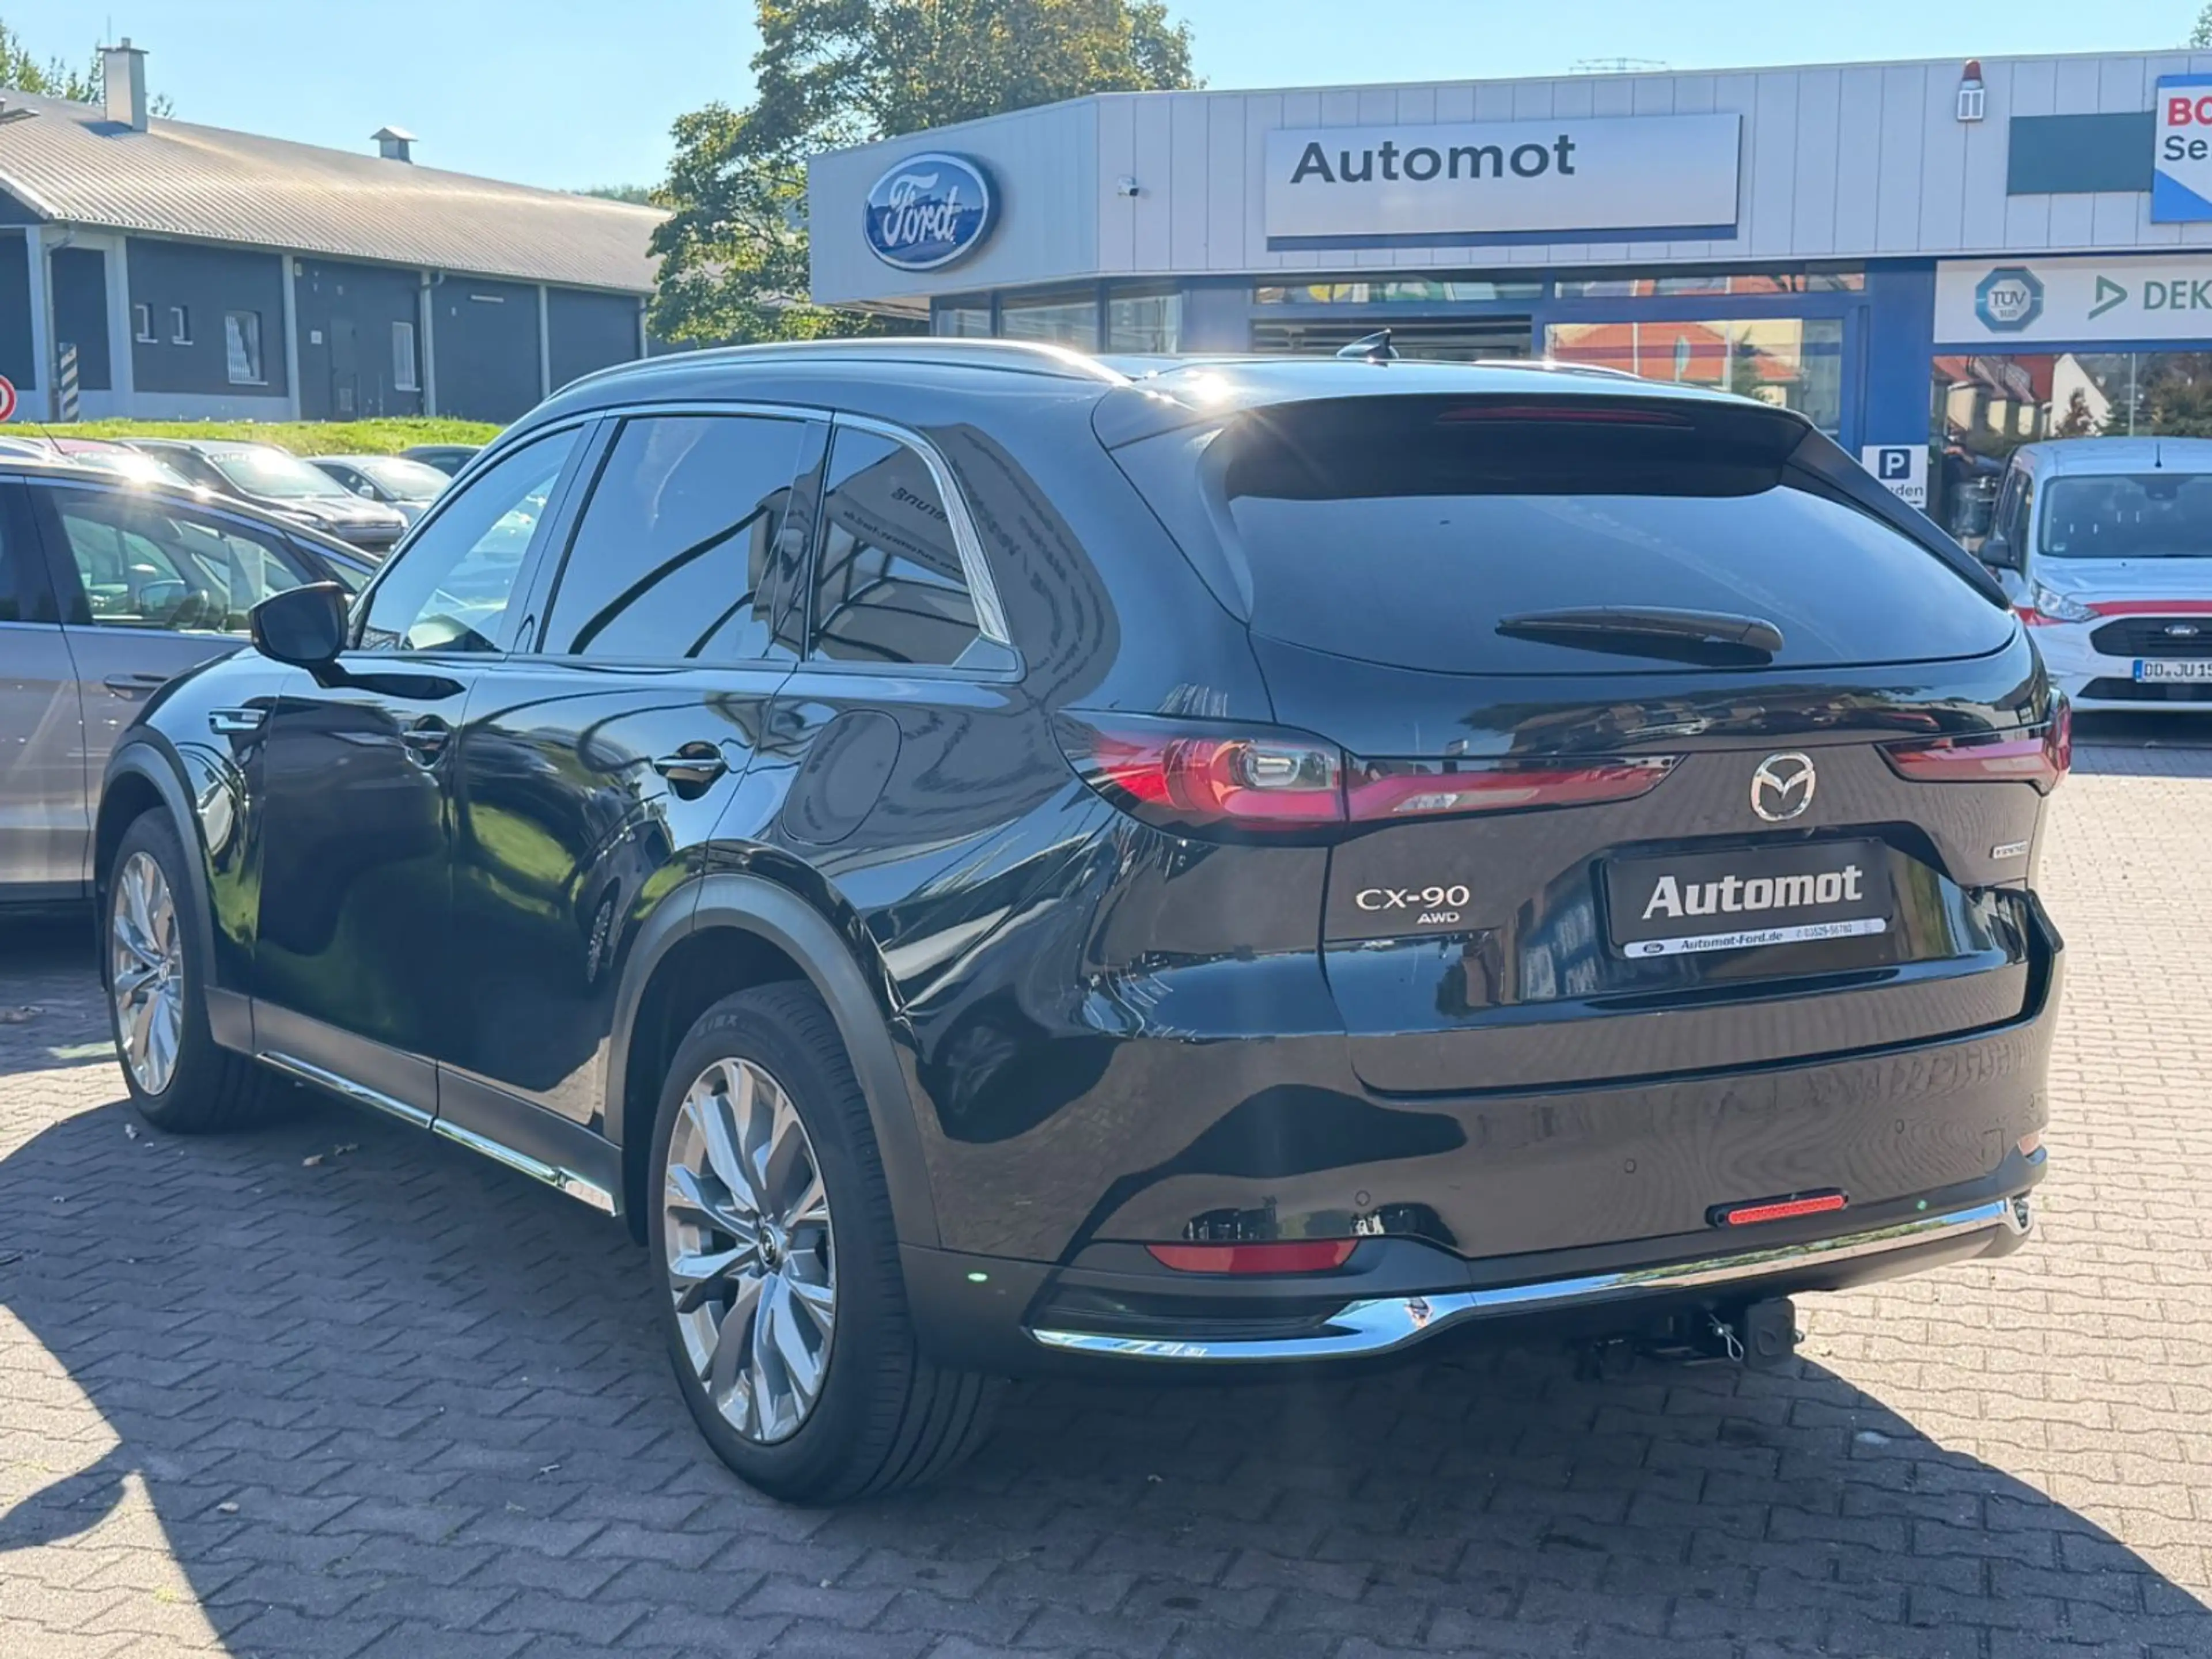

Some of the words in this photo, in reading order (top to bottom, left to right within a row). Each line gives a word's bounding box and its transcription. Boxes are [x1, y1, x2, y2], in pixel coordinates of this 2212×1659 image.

[1289, 134, 1576, 184] Automot
[2163, 135, 2212, 161] Se
[883, 172, 963, 247] Ford
[2143, 279, 2212, 310] DEK
[1885, 452, 1905, 476] P
[1890, 483, 1924, 497] den
[1355, 885, 1470, 911] CX-90
[1642, 864, 1863, 919] Automot
[1416, 911, 1461, 925] AWD
[1680, 930, 1784, 952] Automot-Ford.de
